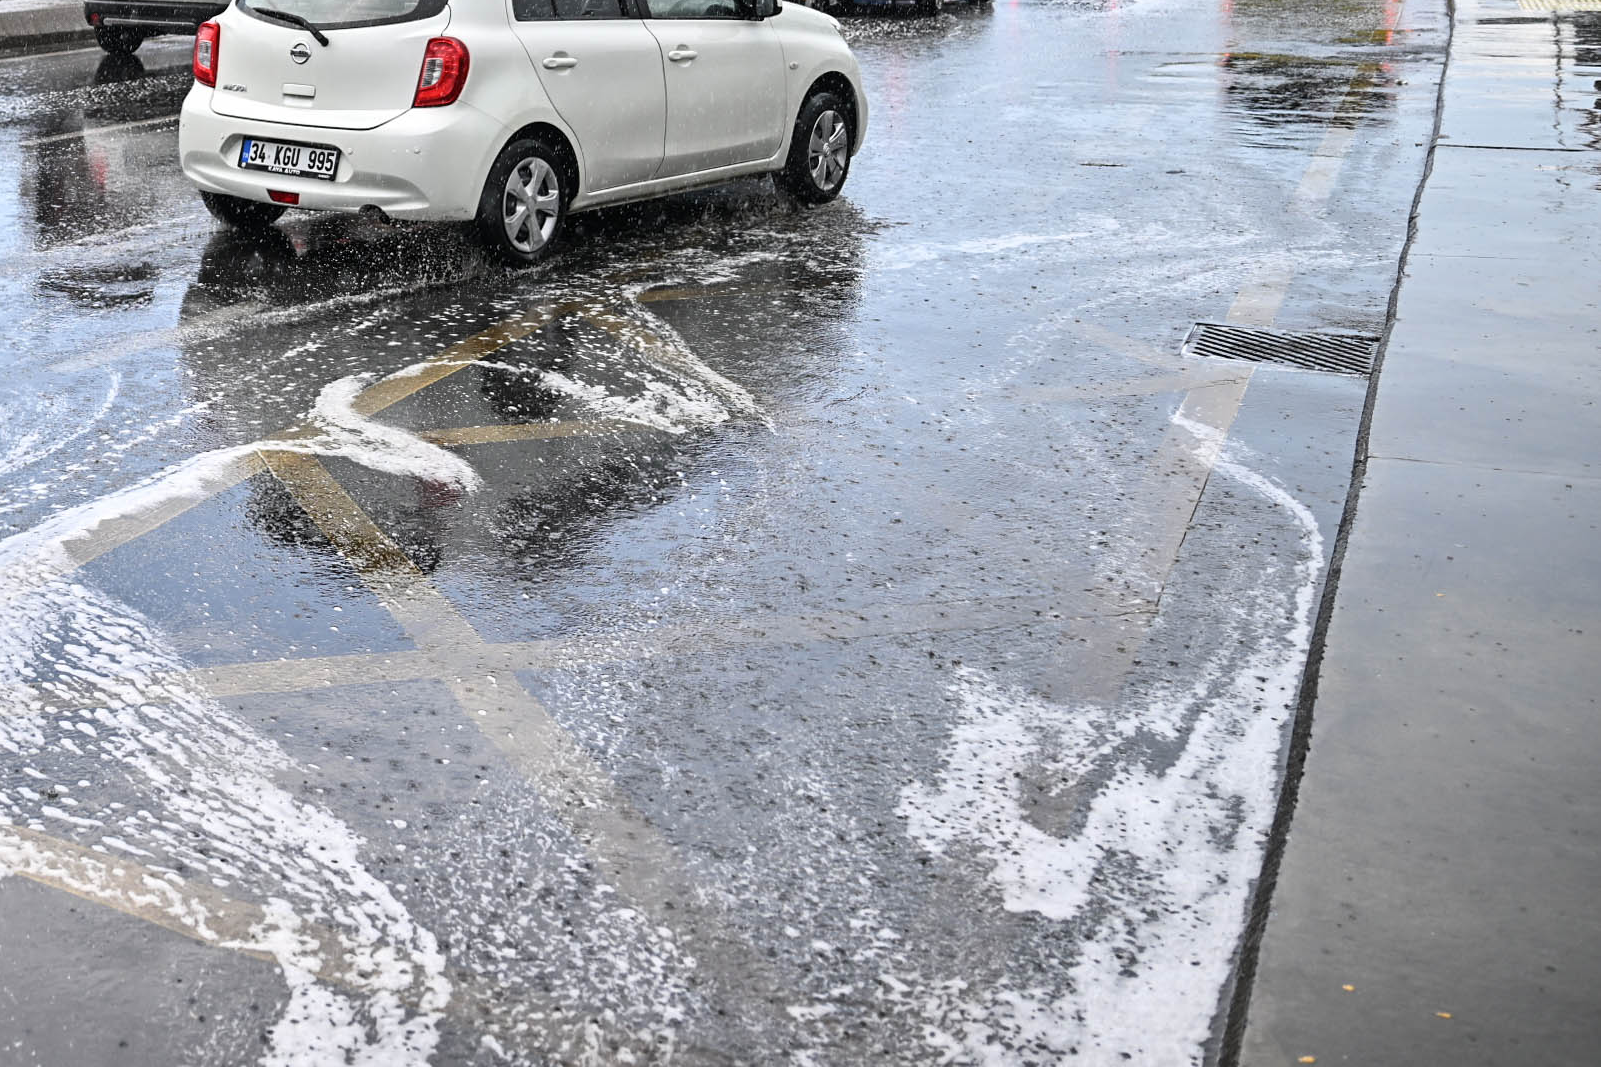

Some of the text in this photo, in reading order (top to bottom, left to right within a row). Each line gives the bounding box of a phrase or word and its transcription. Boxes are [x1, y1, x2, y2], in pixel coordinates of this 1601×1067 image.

[250, 143, 335, 172] 34 KGU 995
